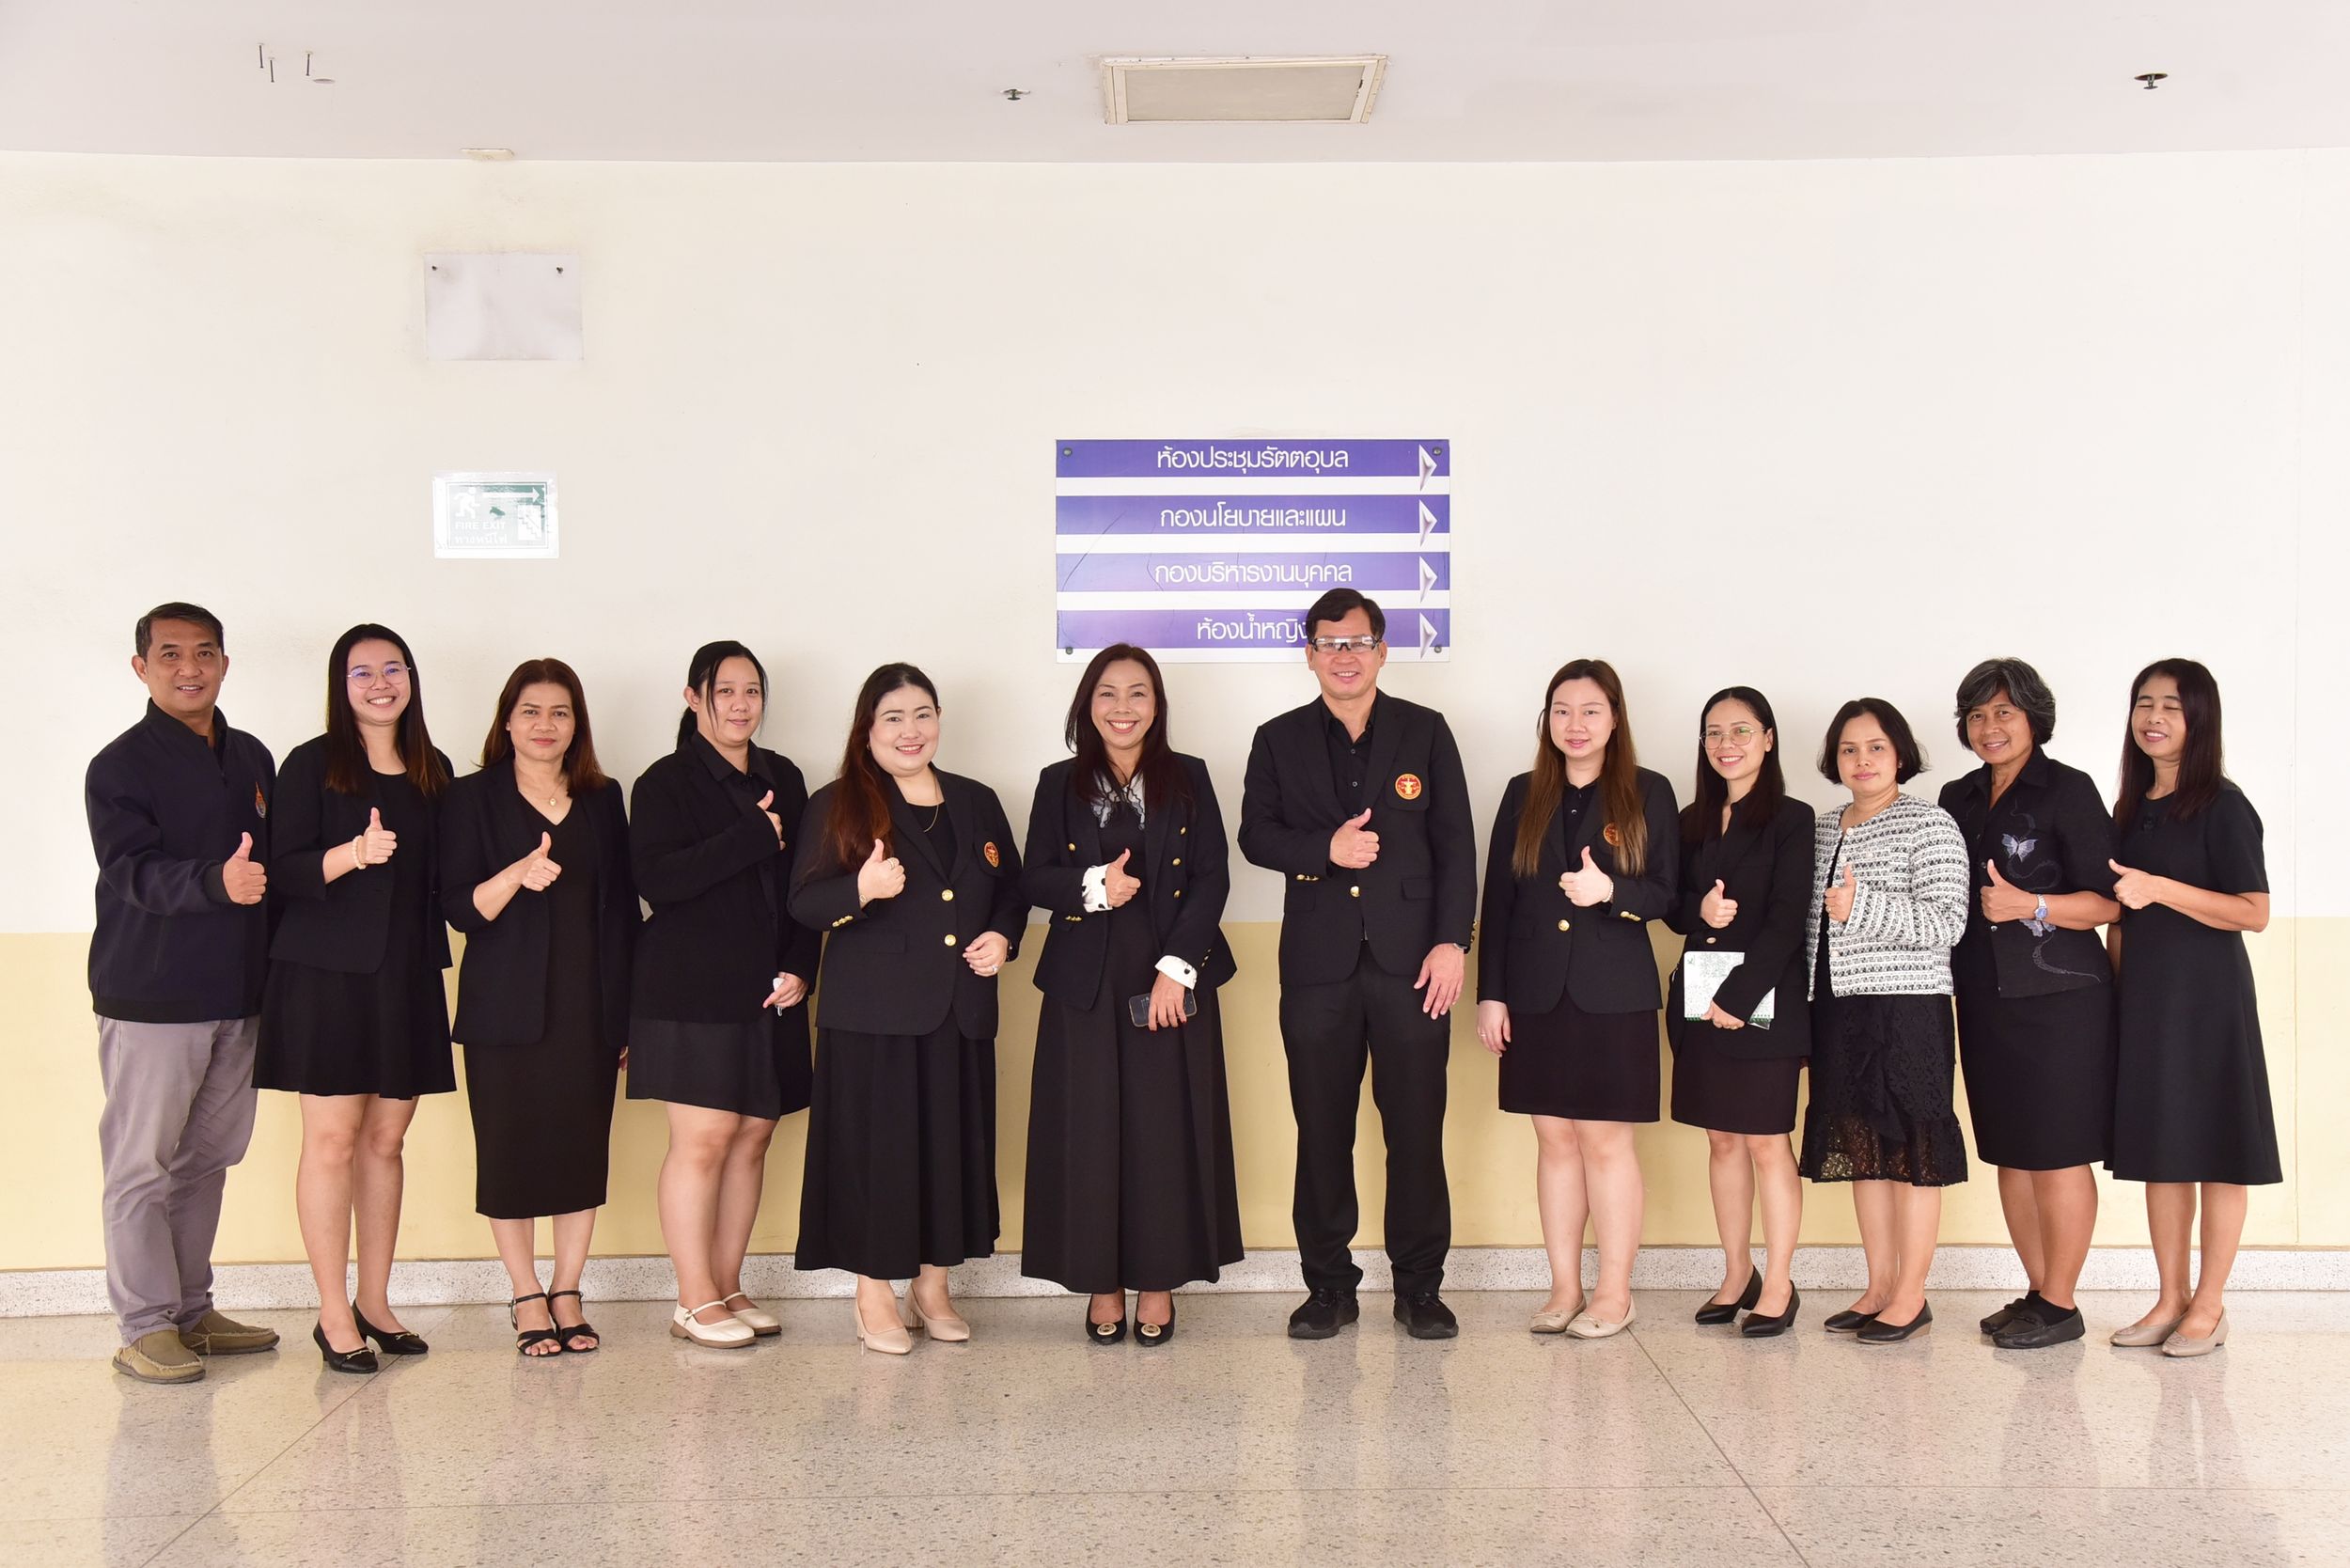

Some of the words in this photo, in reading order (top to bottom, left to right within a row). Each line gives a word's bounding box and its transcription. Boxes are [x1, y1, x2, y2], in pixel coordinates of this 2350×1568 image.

[1157, 446, 1349, 474] ห้องประชุมรัตตอุบล
[455, 521, 479, 529] FIRE
[482, 520, 506, 530] EXIT
[1161, 501, 1346, 526] กองนโยบายและแผน
[1155, 562, 1352, 588] กองบริหารงานบุคคล
